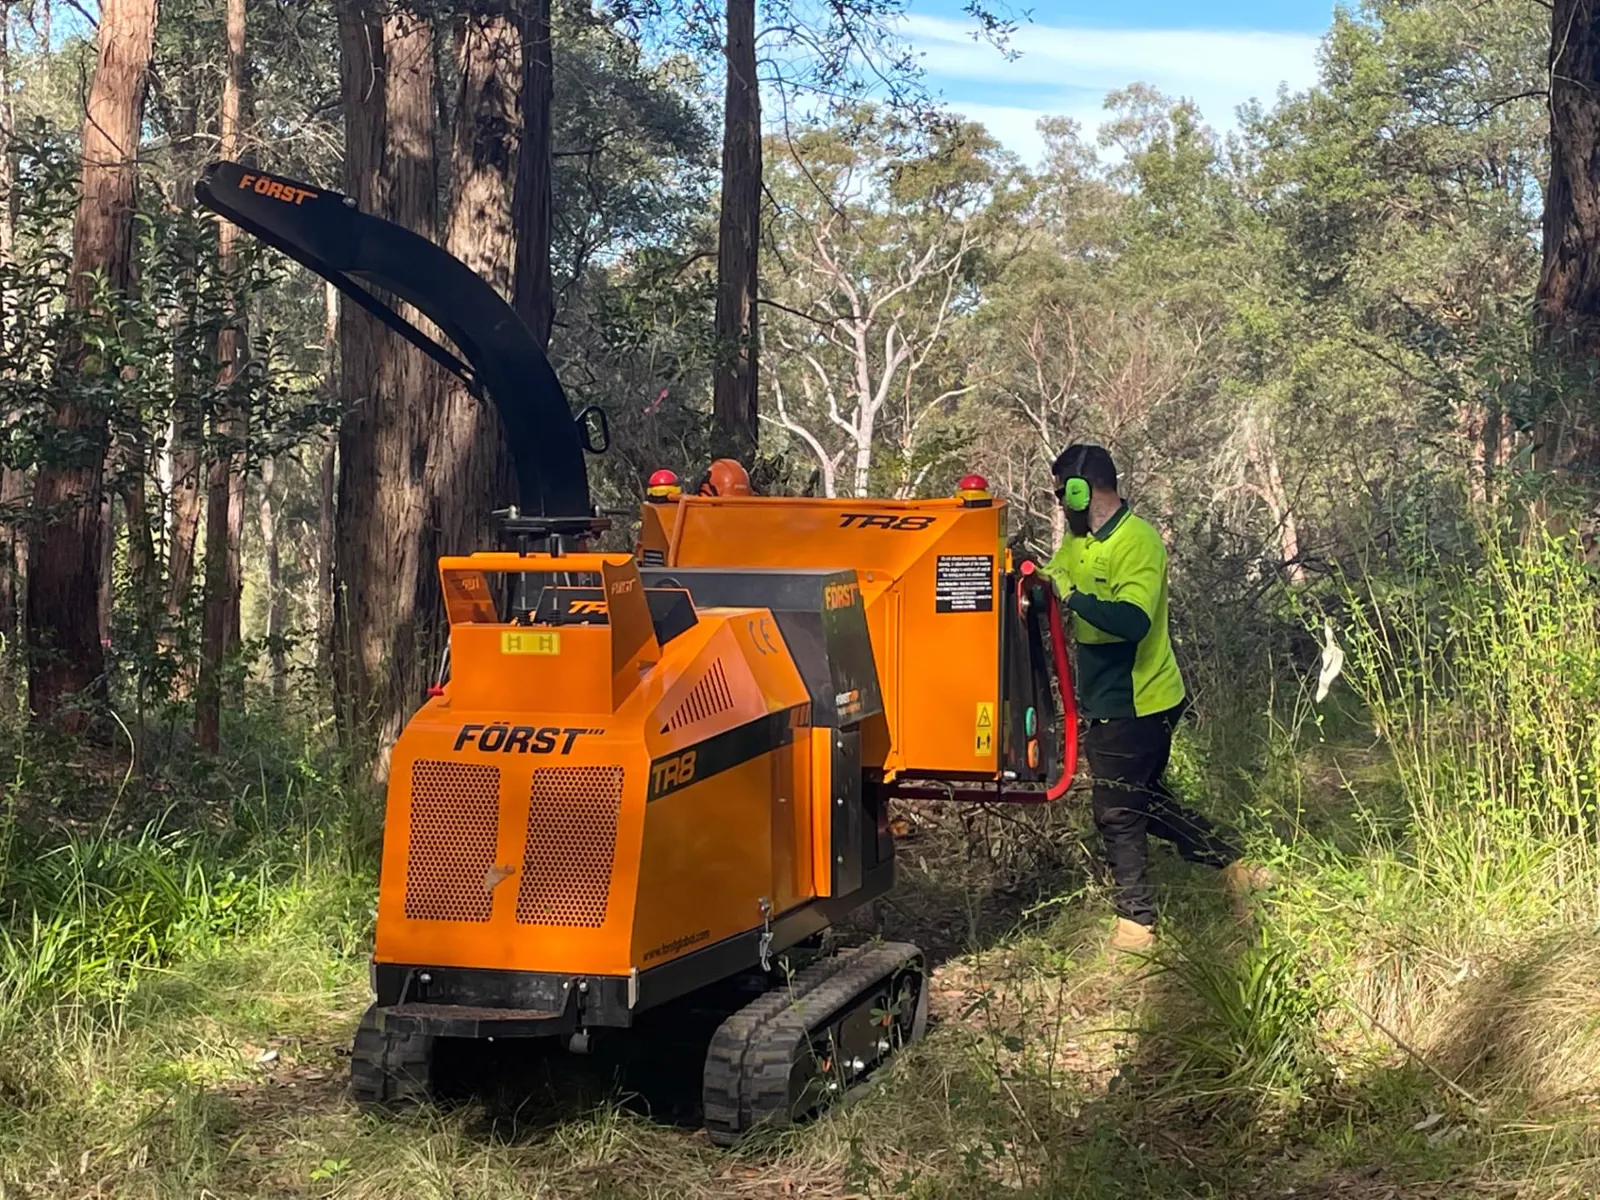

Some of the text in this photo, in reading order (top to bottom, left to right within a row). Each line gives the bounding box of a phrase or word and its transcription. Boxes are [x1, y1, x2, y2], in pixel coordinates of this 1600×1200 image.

[238, 173, 318, 205] FÖRST
[839, 513, 937, 531] TR8
[568, 600, 608, 614] TR
[453, 720, 604, 755] FÖRST
[652, 750, 697, 794] TR8
